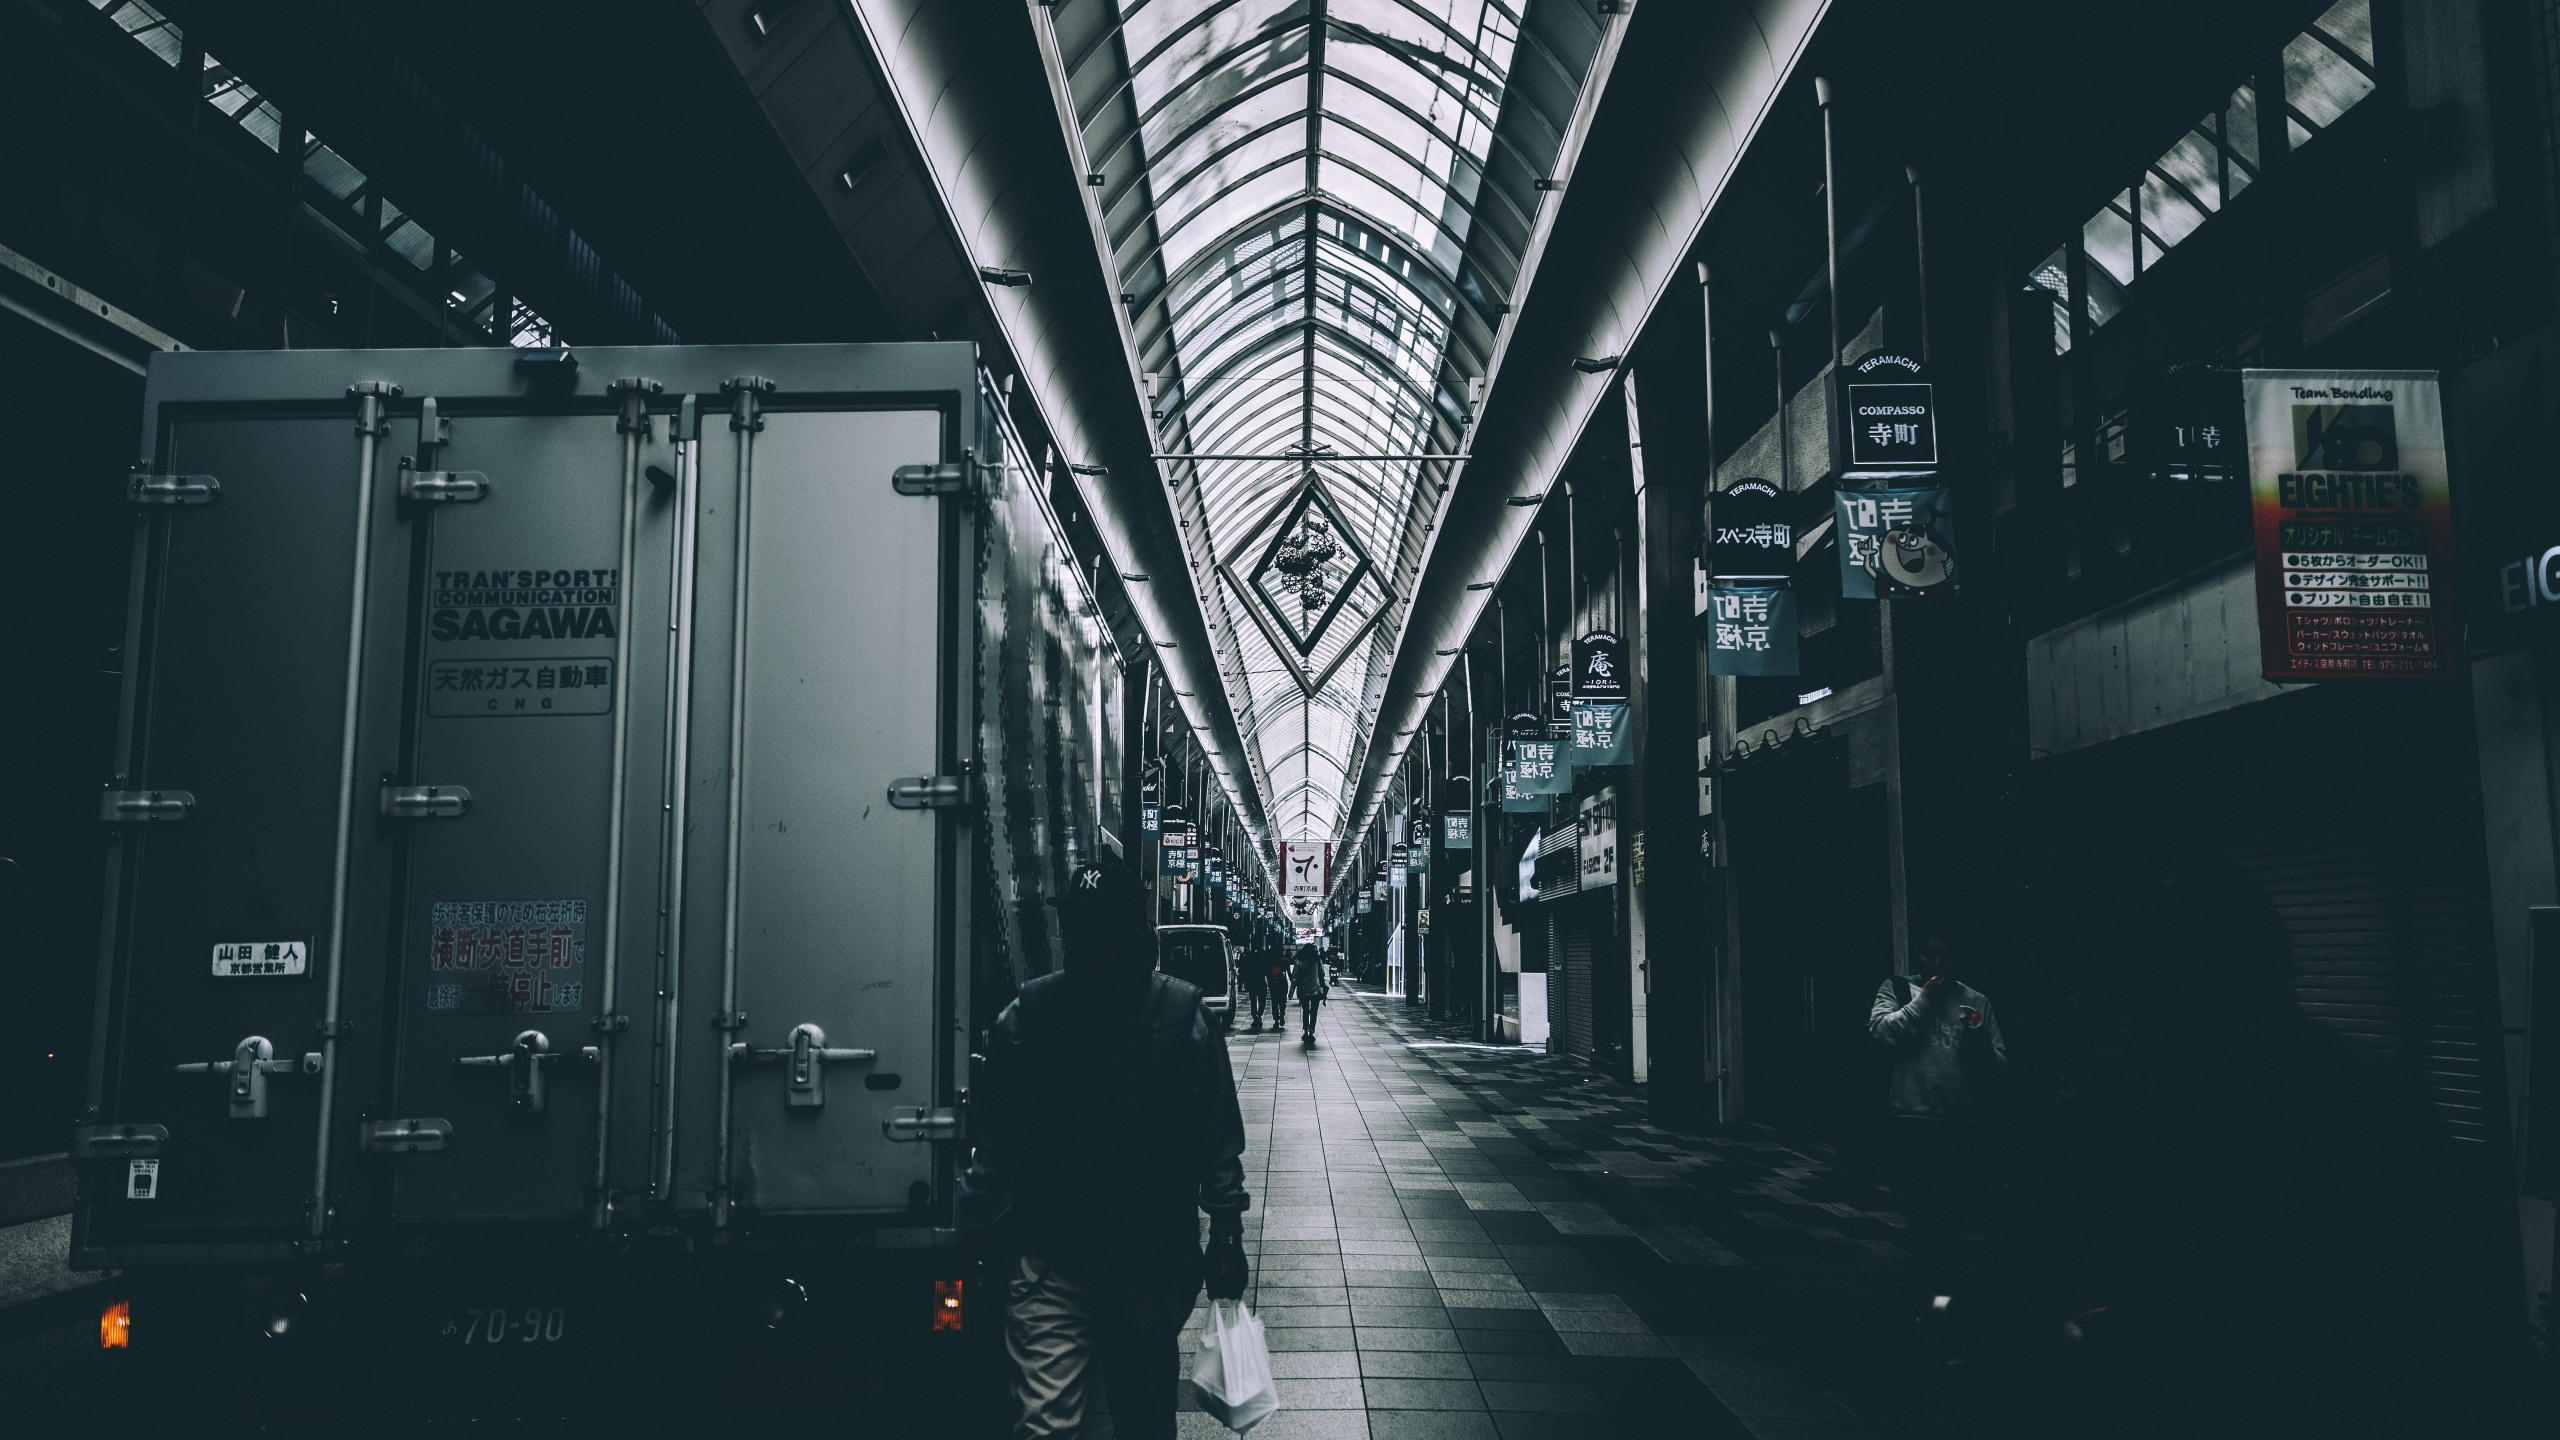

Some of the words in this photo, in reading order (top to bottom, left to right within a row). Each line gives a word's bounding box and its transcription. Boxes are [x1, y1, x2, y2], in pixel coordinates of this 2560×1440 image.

[1857, 355, 1922, 374] TERAMACHI
[2290, 386, 2328, 400] Team
[2330, 387, 2394, 402] Bonding
[1858, 405, 1926, 416] COMPASSO
[1867, 422, 1920, 447] 寺町
[1728, 482, 1777, 499] TERAMACHI
[2278, 474, 2421, 510] EIGHTIE'S
[1716, 522, 1791, 549] スペース寺町
[435, 569, 618, 589] TRAN'SPORT!
[437, 590, 612, 605] COMMUNICATION
[431, 607, 617, 641] SAGAWA
[1583, 632, 1618, 646] TERAMACHI
[1588, 650, 1614, 677] 庵
[434, 665, 608, 692] 天然ガス自動車
[218, 945, 254, 961] 山田
[230, 962, 286, 975] 京都営業所
[464, 1307, 566, 1345] 70-90
